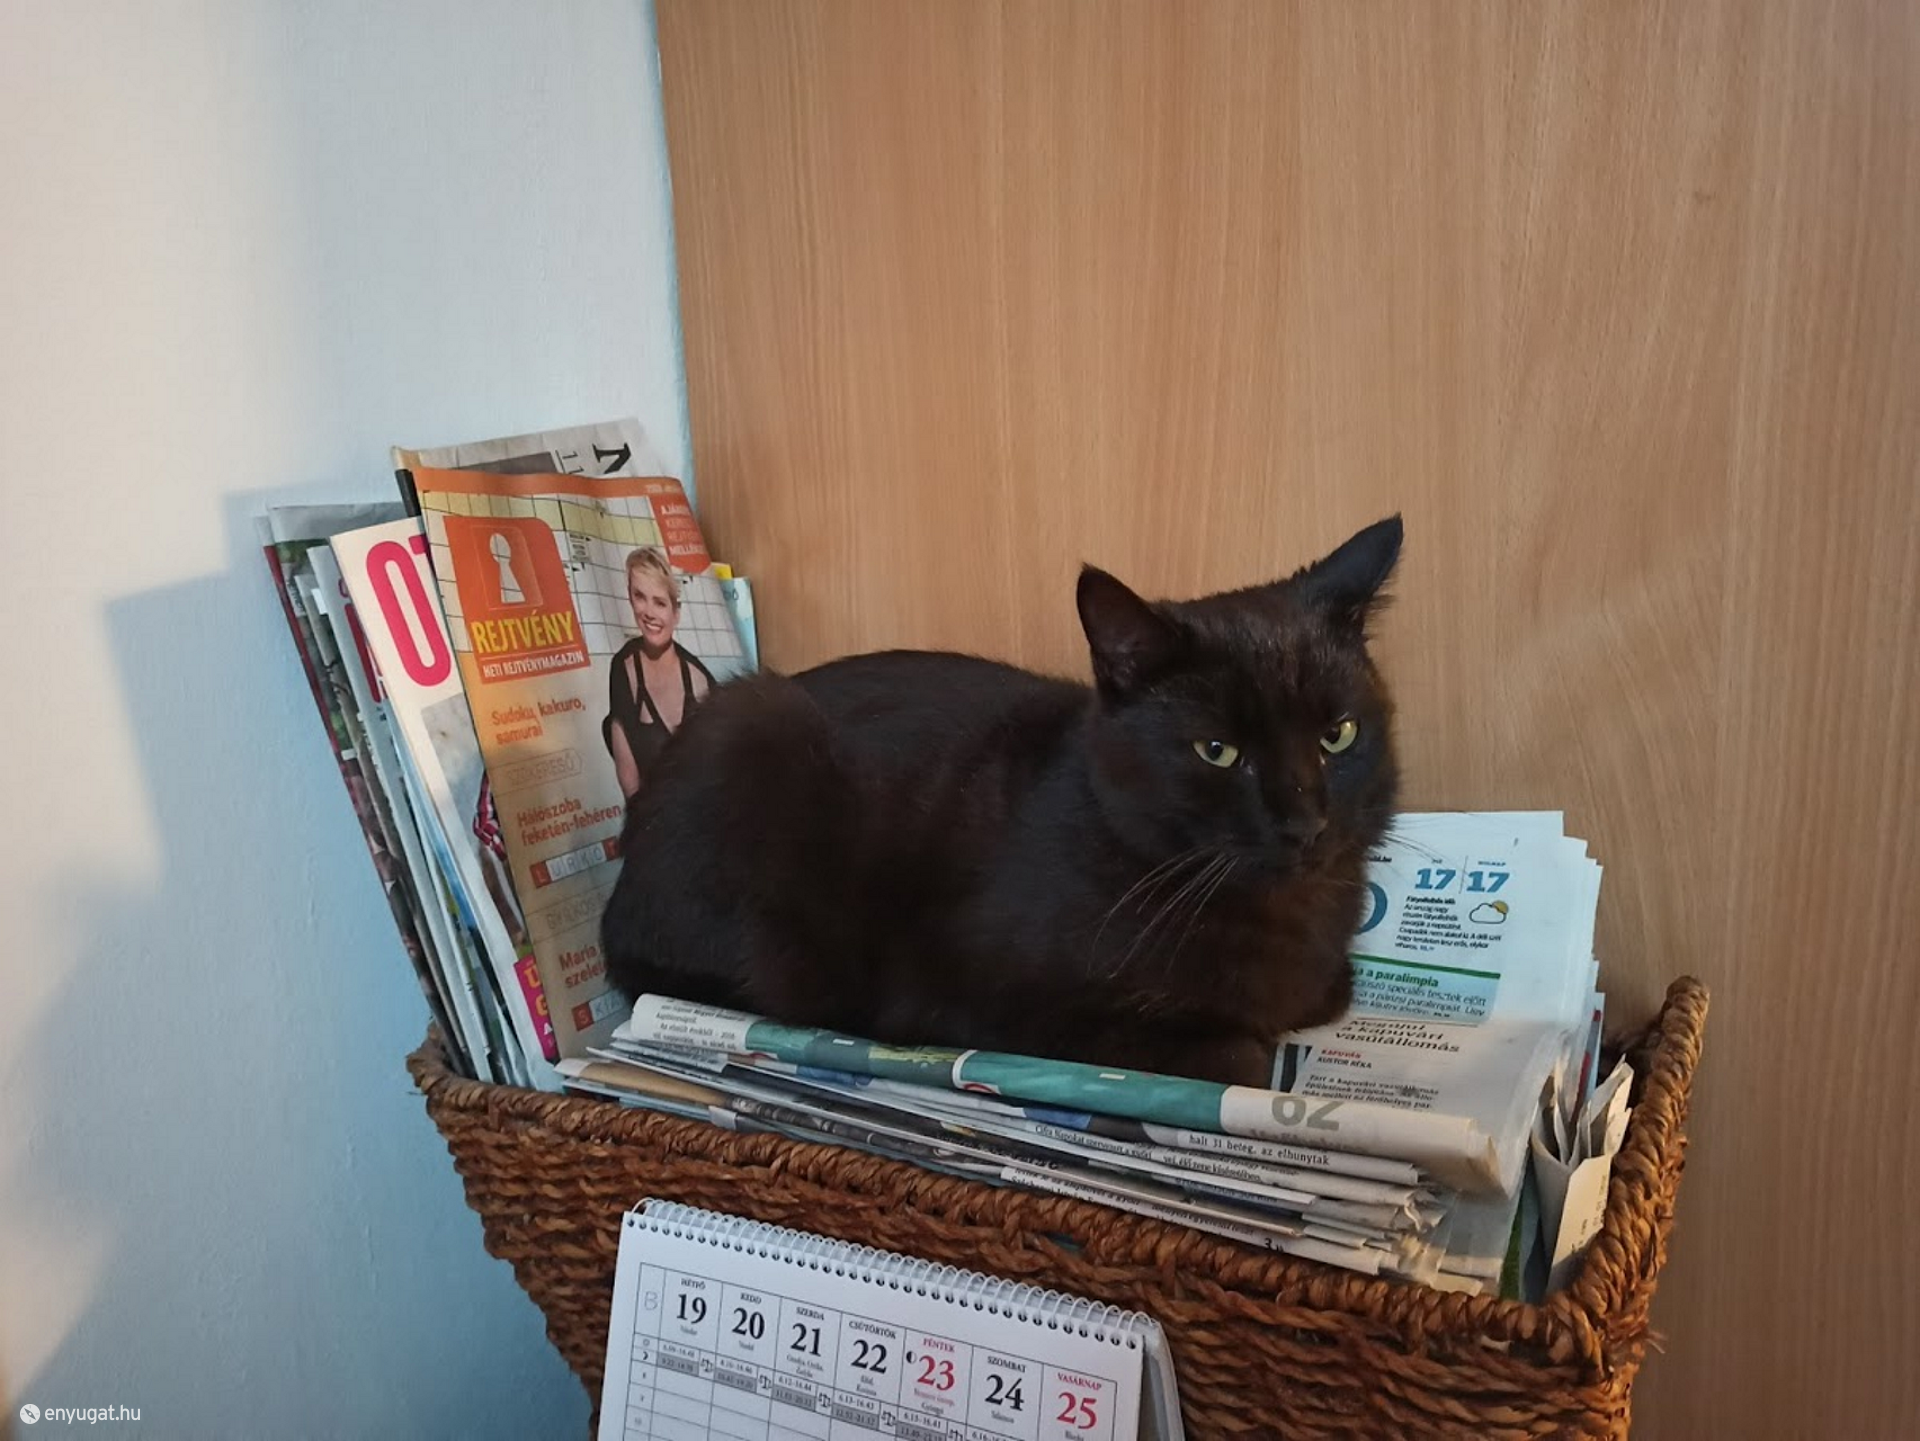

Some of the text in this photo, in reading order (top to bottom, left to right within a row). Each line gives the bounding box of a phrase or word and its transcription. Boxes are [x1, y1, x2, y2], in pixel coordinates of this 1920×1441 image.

[471, 610, 574, 654] REJTVÉNY
[483, 651, 585, 678] HETI REJTVÉNYMAGAZIN
[537, 697, 586, 717] kakuro,
[495, 724, 544, 745] samurai
[517, 798, 582, 828] Hálószoba
[521, 805, 622, 846] feketén-fehéren
[1415, 868, 1510, 893] 17 17
[1366, 969, 1374, 977] a
[1375, 970, 1439, 987] paralimpia
[1387, 983, 1426, 997] speciális
[1427, 987, 1461, 1002] tesztek
[1333, 1031, 1460, 1053] vasútállomás
[1358, 1026, 1445, 1041] kapuvári
[1350, 1059, 1373, 1070] RÉKA
[1189, 1134, 1208, 1146] halt
[1212, 1138, 1223, 1149] 31
[1261, 1147, 1273, 1157] az
[1277, 1146, 1330, 1166] elhunytak
[680, 1277, 706, 1291] HÉTFŐ
[676, 1293, 707, 1325] 19
[740, 1292, 762, 1305] KEDD
[731, 1307, 766, 1340] 20
[796, 1306, 825, 1321] SZERDA
[790, 1322, 822, 1358] 21
[848, 1320, 897, 1340] CSÜTÖRTÖK
[923, 1337, 955, 1353] PÉNTEK
[850, 1338, 888, 1375] 22
[987, 1355, 1026, 1374] SZOMBAT
[916, 1354, 956, 1391] 23
[1057, 1372, 1103, 1392] VASÁRNAP
[984, 1373, 1025, 1412] 24
[1055, 1391, 1098, 1430] 25
